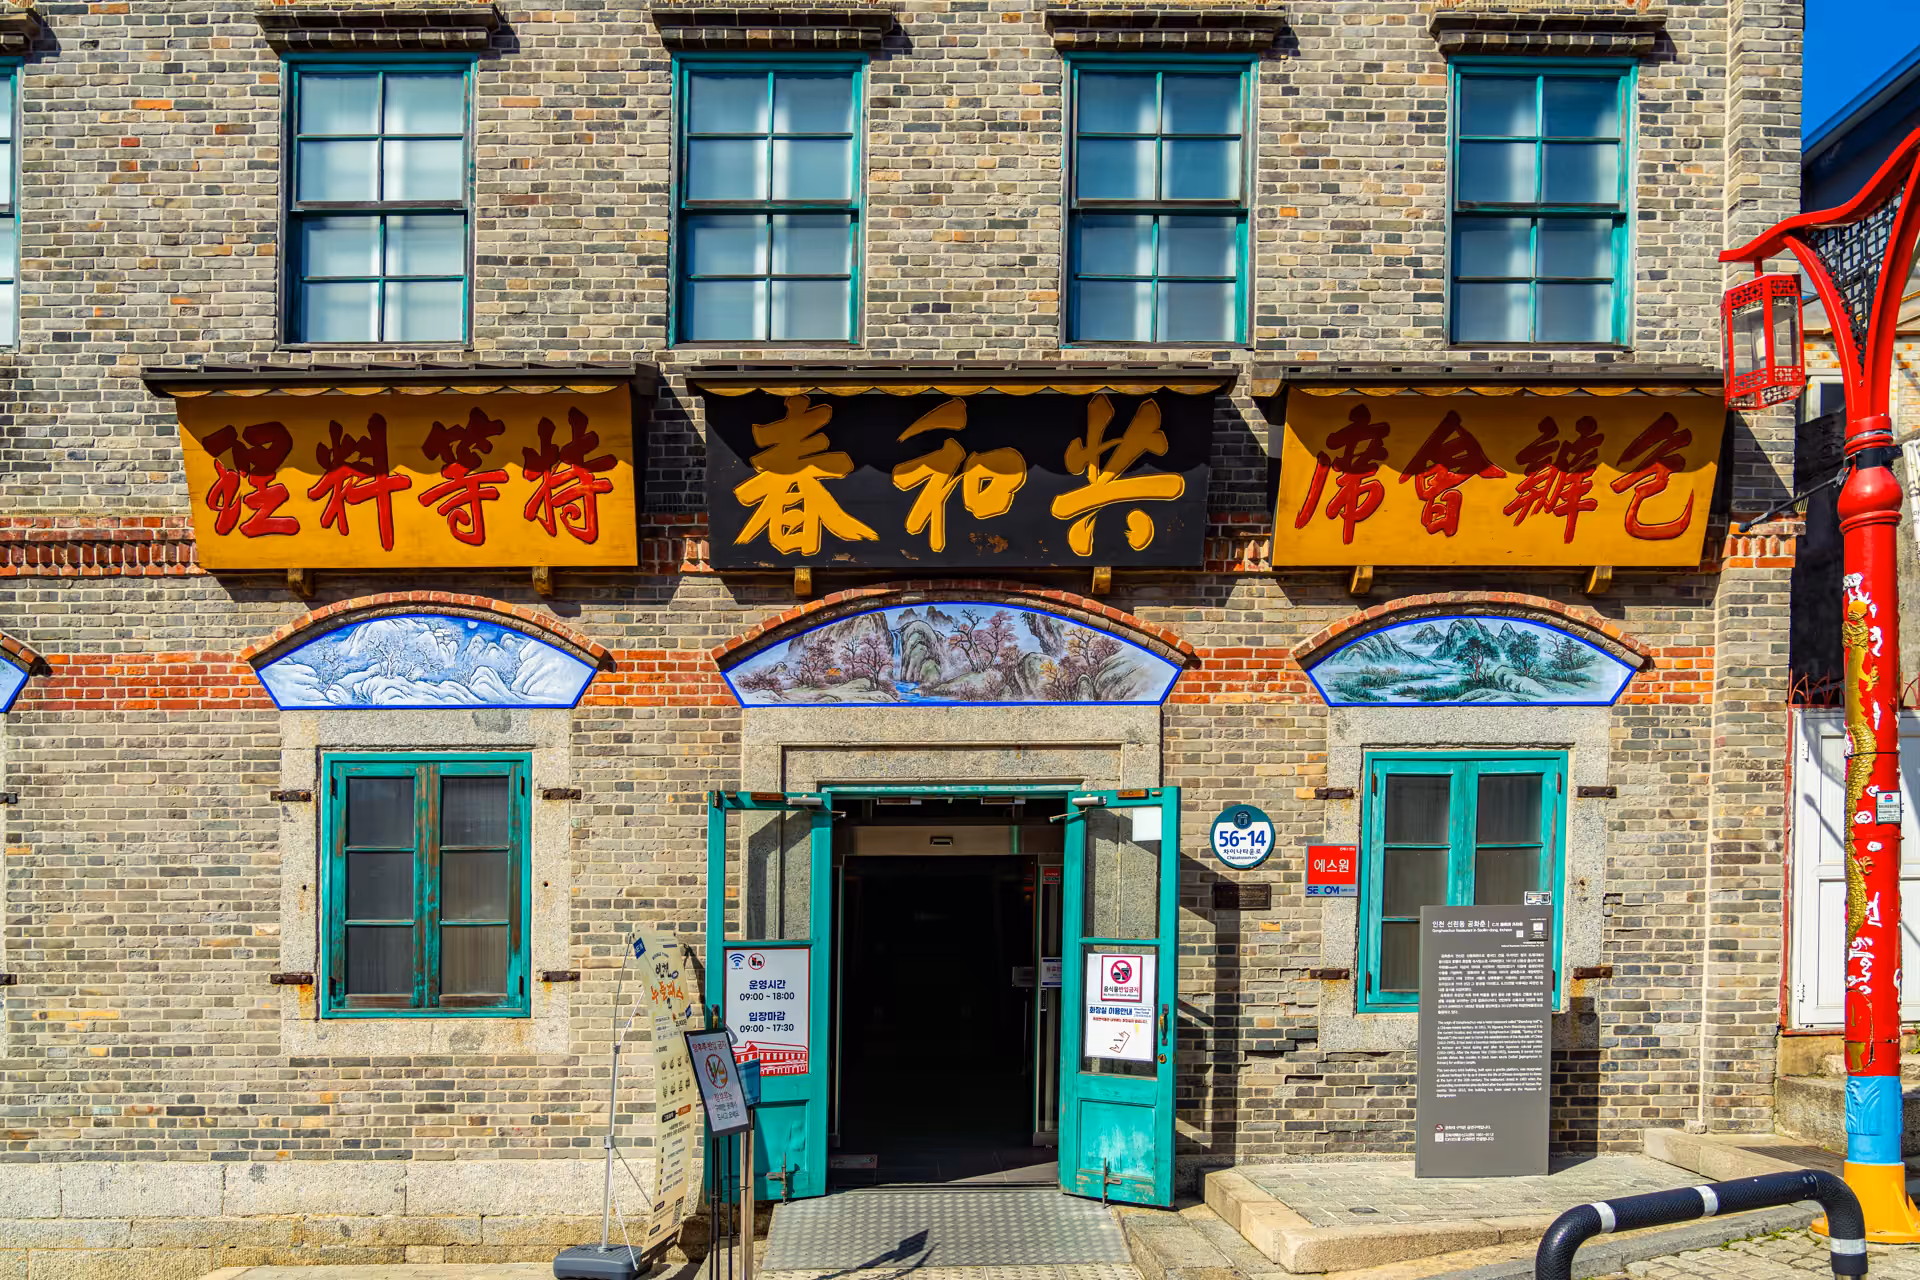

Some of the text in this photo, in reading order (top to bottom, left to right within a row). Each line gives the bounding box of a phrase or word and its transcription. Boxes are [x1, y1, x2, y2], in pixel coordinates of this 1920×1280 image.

[1219, 830, 1266, 847] 56-14
[1313, 858, 1350, 873] 에스원
[1307, 885, 1340, 895] SECOM
[749, 979, 787, 990] 운영시간
[739, 992, 764, 1001] 09:00
[772, 991, 795, 1000] 18:00
[1089, 1006, 1106, 1014] 화장실
[1109, 1007, 1132, 1015] 이용안내
[748, 1011, 786, 1022] 입장마감
[739, 1024, 764, 1033] 09:00
[772, 1023, 794, 1032] 17:30
